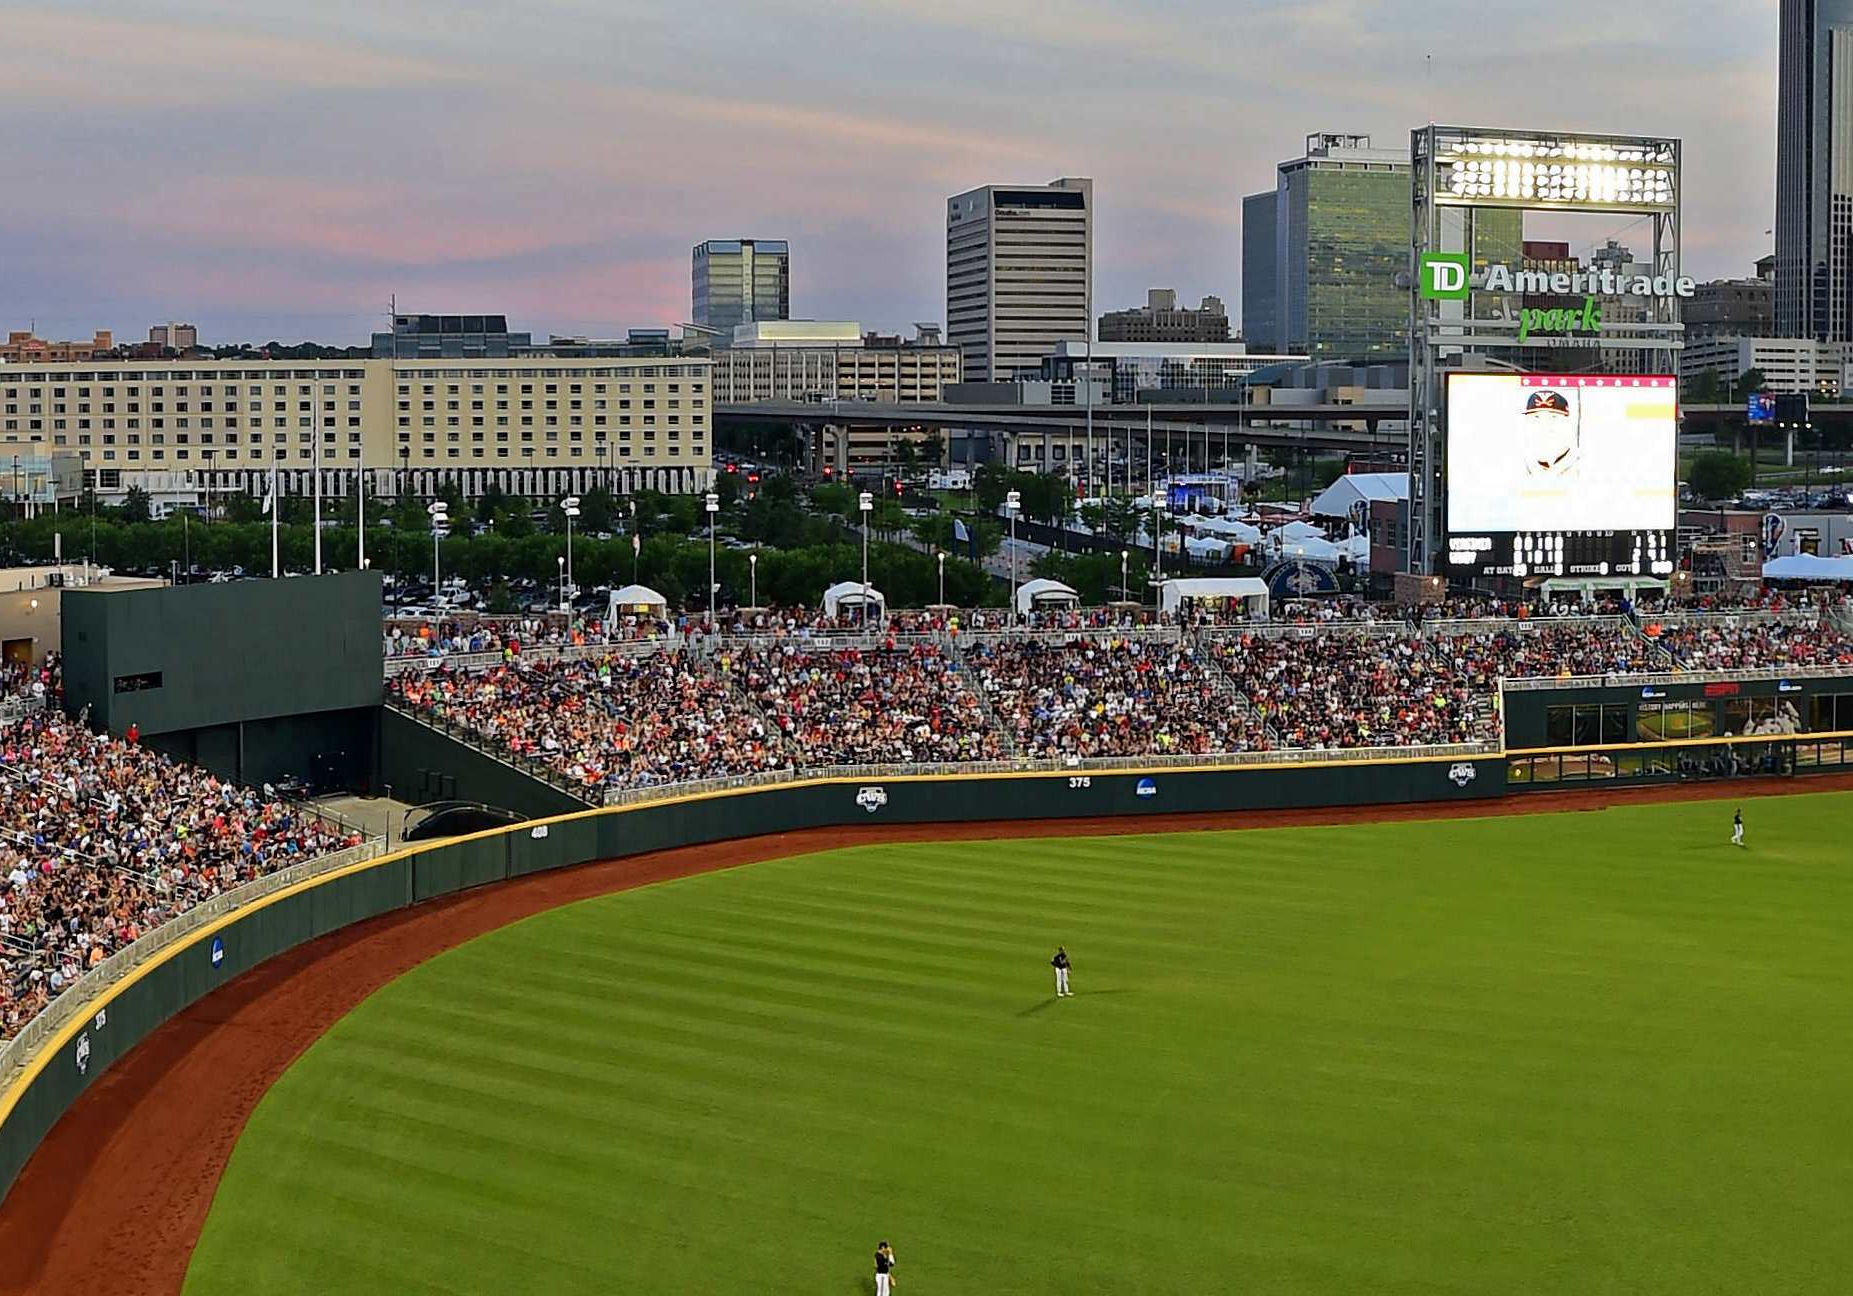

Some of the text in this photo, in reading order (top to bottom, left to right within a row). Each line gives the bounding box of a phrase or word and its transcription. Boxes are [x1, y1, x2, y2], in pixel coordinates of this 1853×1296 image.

[1427, 261, 1695, 297] TD Ameritrade
[1519, 296, 1602, 344] park
[1069, 777, 1091, 788] 375
